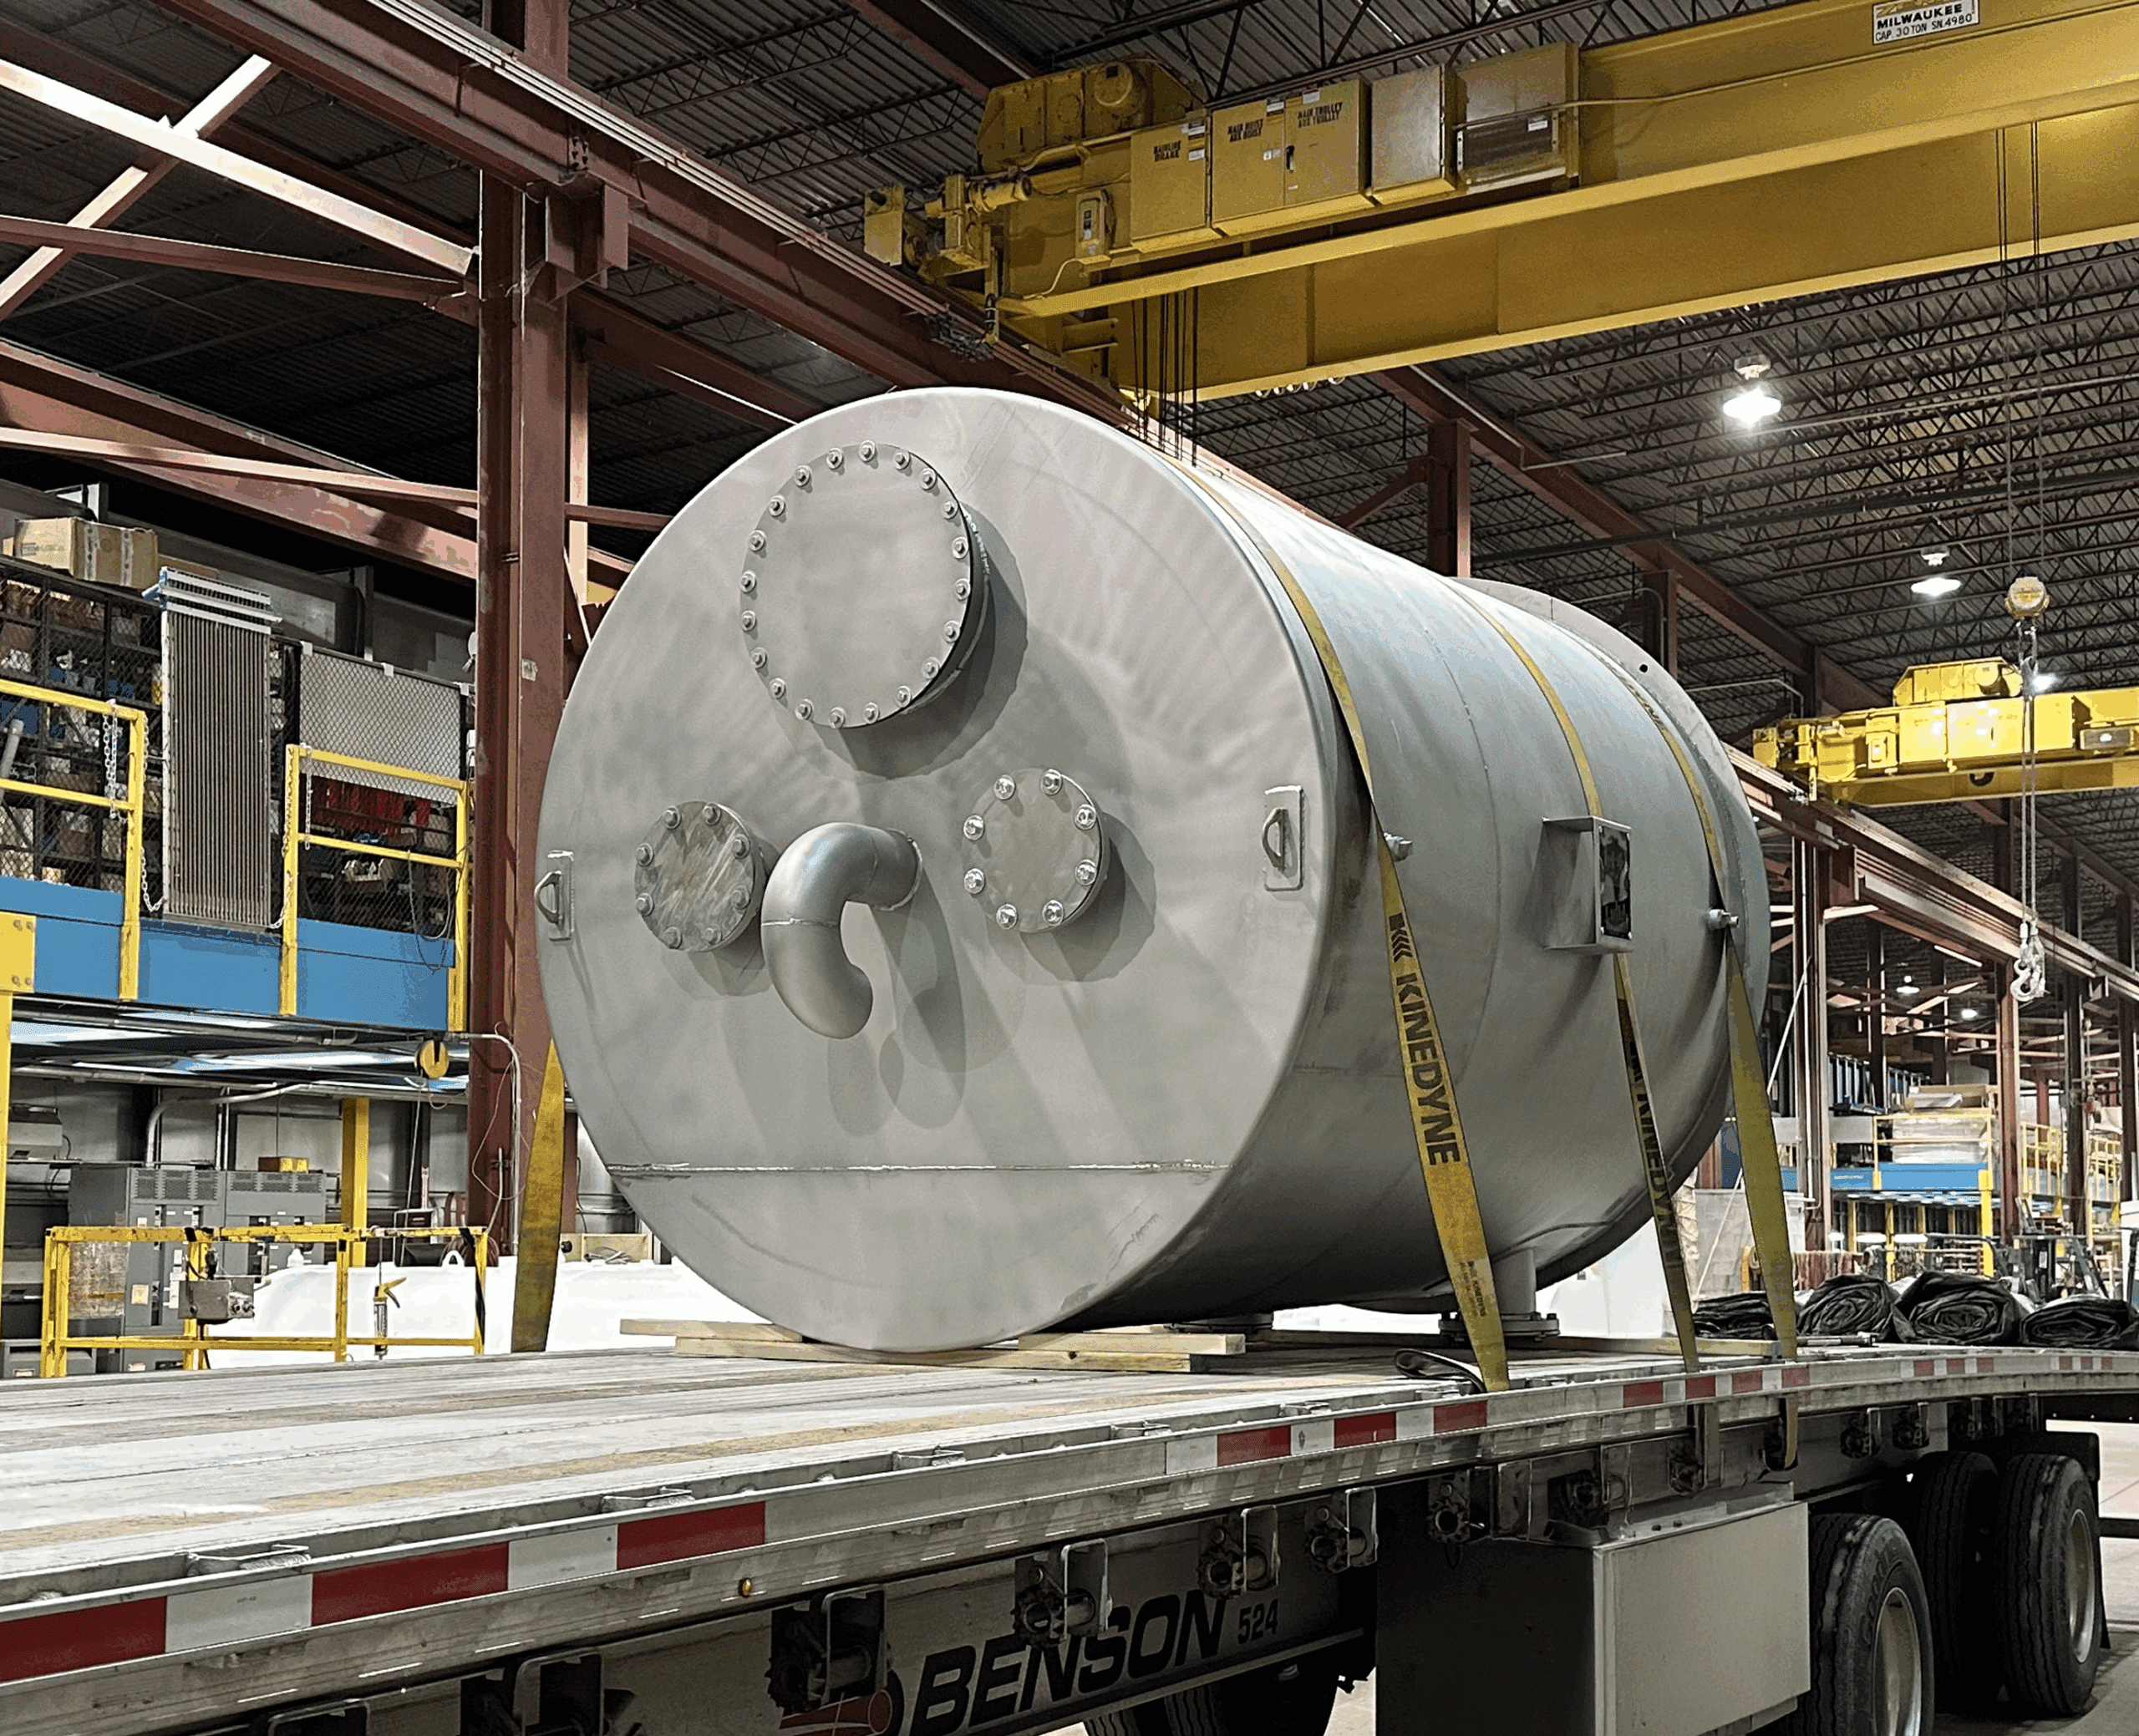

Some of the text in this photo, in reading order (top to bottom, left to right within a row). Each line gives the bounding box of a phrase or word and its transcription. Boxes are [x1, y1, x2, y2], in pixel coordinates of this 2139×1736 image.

[1877, 3, 1963, 29] MILWAUKEE
[1396, 972, 1461, 1165] KINEDYNE
[909, 1589, 1278, 1736] BENSON 524
